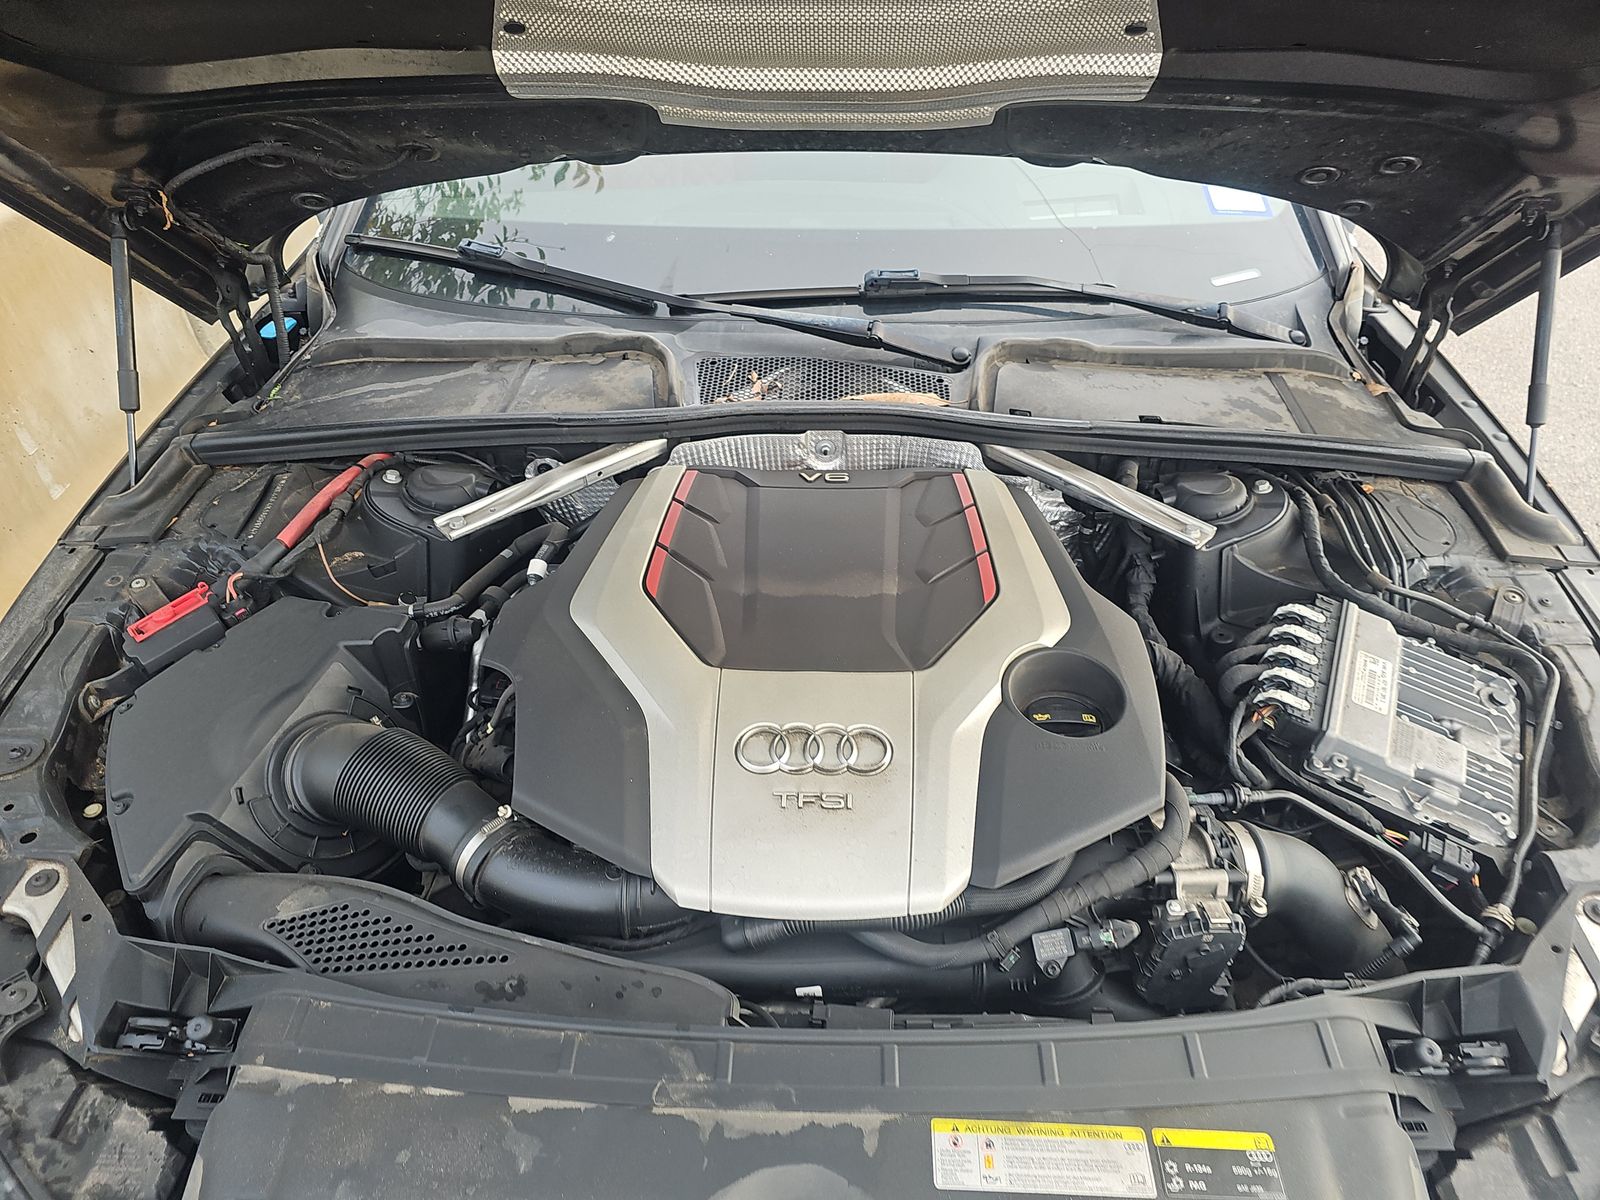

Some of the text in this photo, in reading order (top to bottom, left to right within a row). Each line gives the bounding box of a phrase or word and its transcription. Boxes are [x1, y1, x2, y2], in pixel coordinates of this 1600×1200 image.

[799, 472, 850, 483] V6
[772, 791, 853, 810] TFSI
[964, 1125, 1124, 1140] ACHTUNG WARNING ATTENTION
